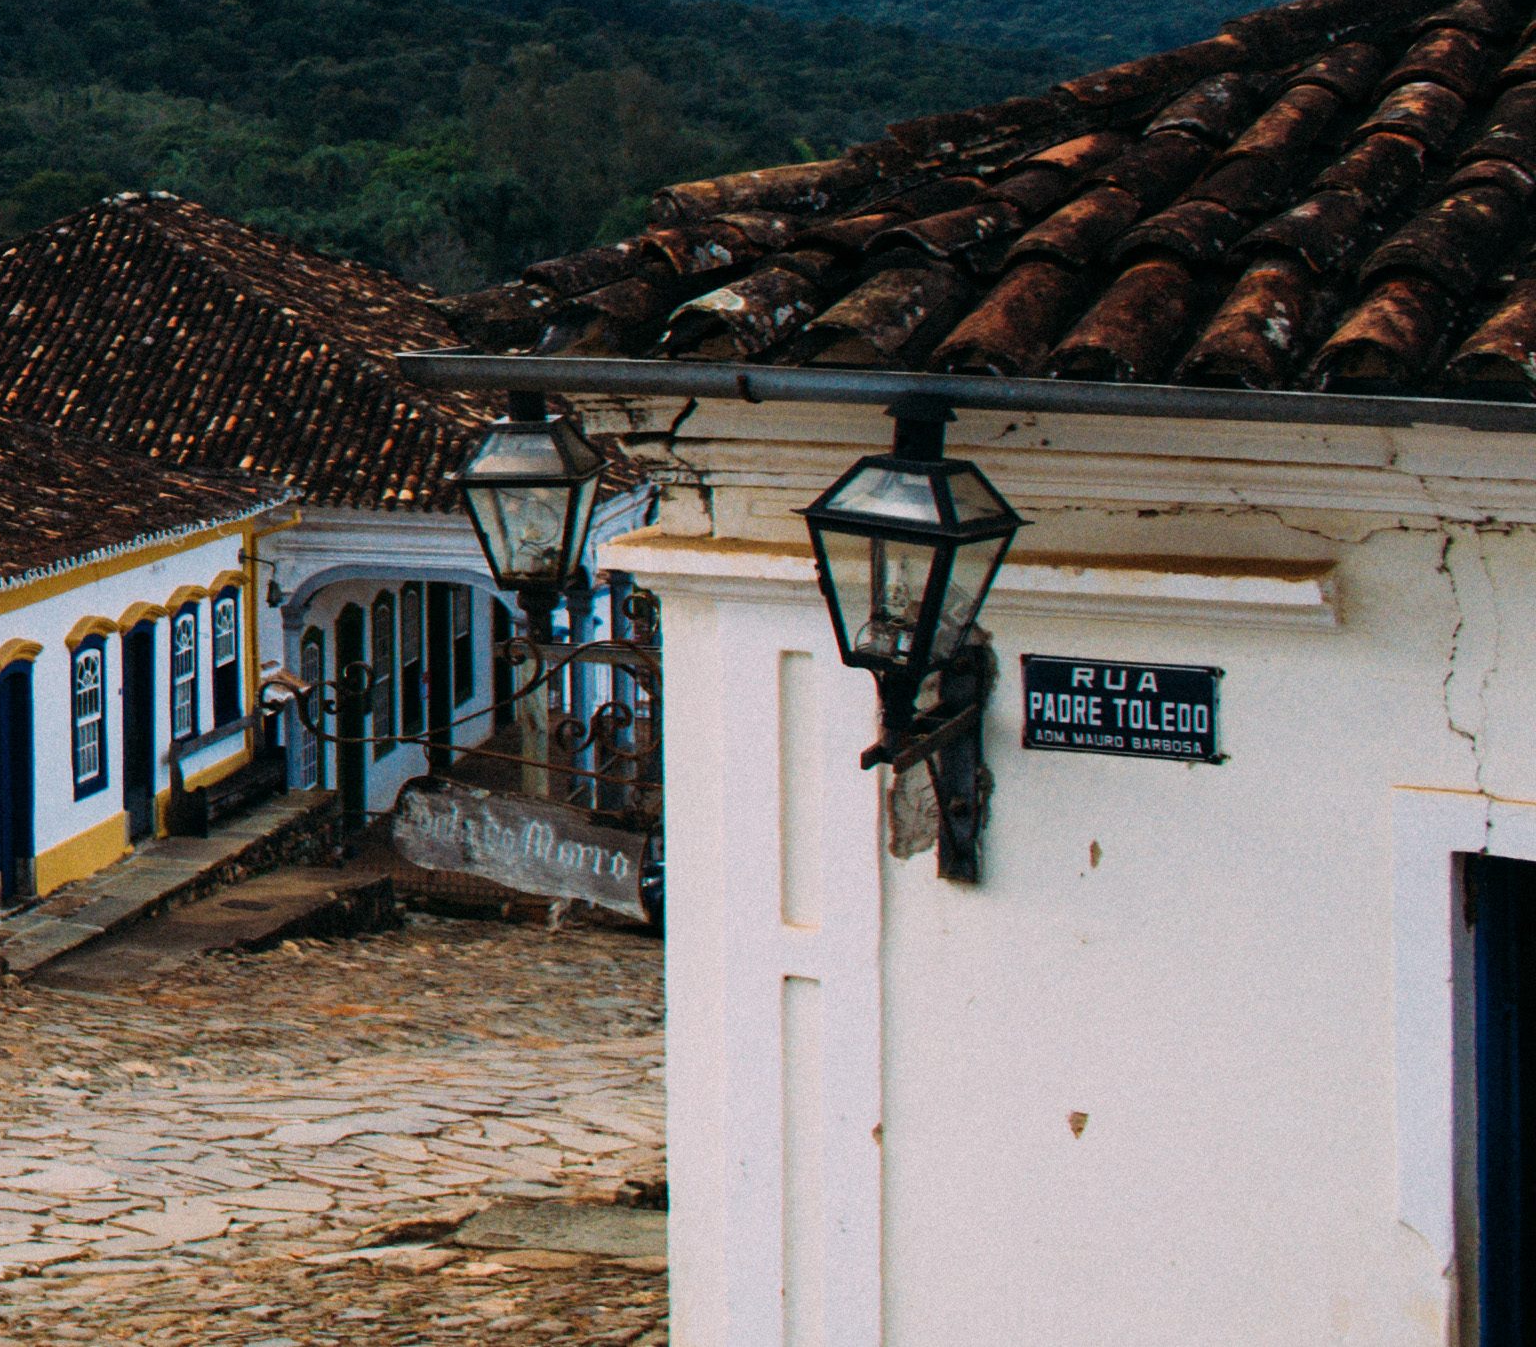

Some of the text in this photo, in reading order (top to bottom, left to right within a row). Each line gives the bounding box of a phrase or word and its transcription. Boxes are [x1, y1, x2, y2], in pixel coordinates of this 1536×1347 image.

[1071, 666, 1158, 693] RUA
[1029, 690, 1209, 734] PADRE TOLEDO
[1035, 729, 1203, 754] ADM. MAURO BARBOSA
[522, 818, 630, 881] Morro
